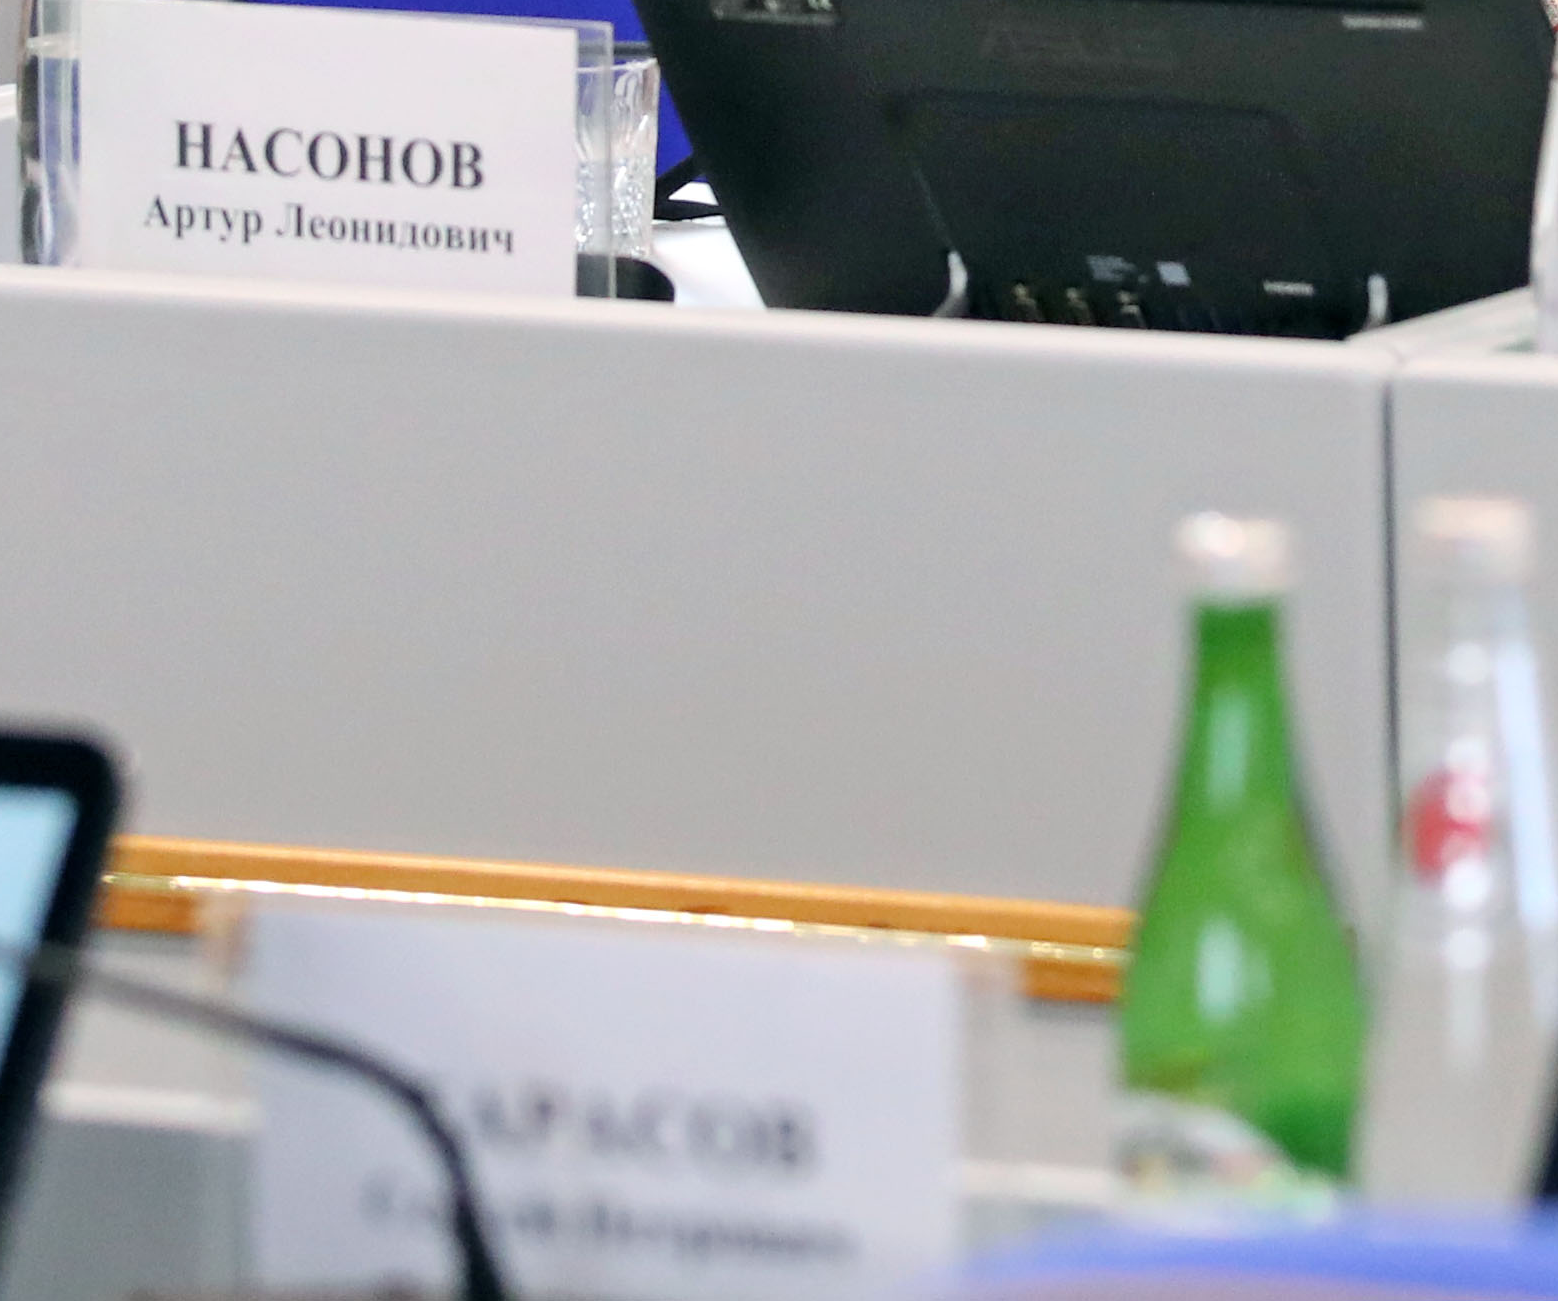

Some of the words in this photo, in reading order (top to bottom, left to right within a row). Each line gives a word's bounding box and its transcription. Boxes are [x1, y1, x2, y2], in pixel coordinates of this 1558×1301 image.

[176, 120, 485, 190] НАСОНОВ
[145, 195, 264, 245] Артур
[276, 203, 514, 254] Леонидович
